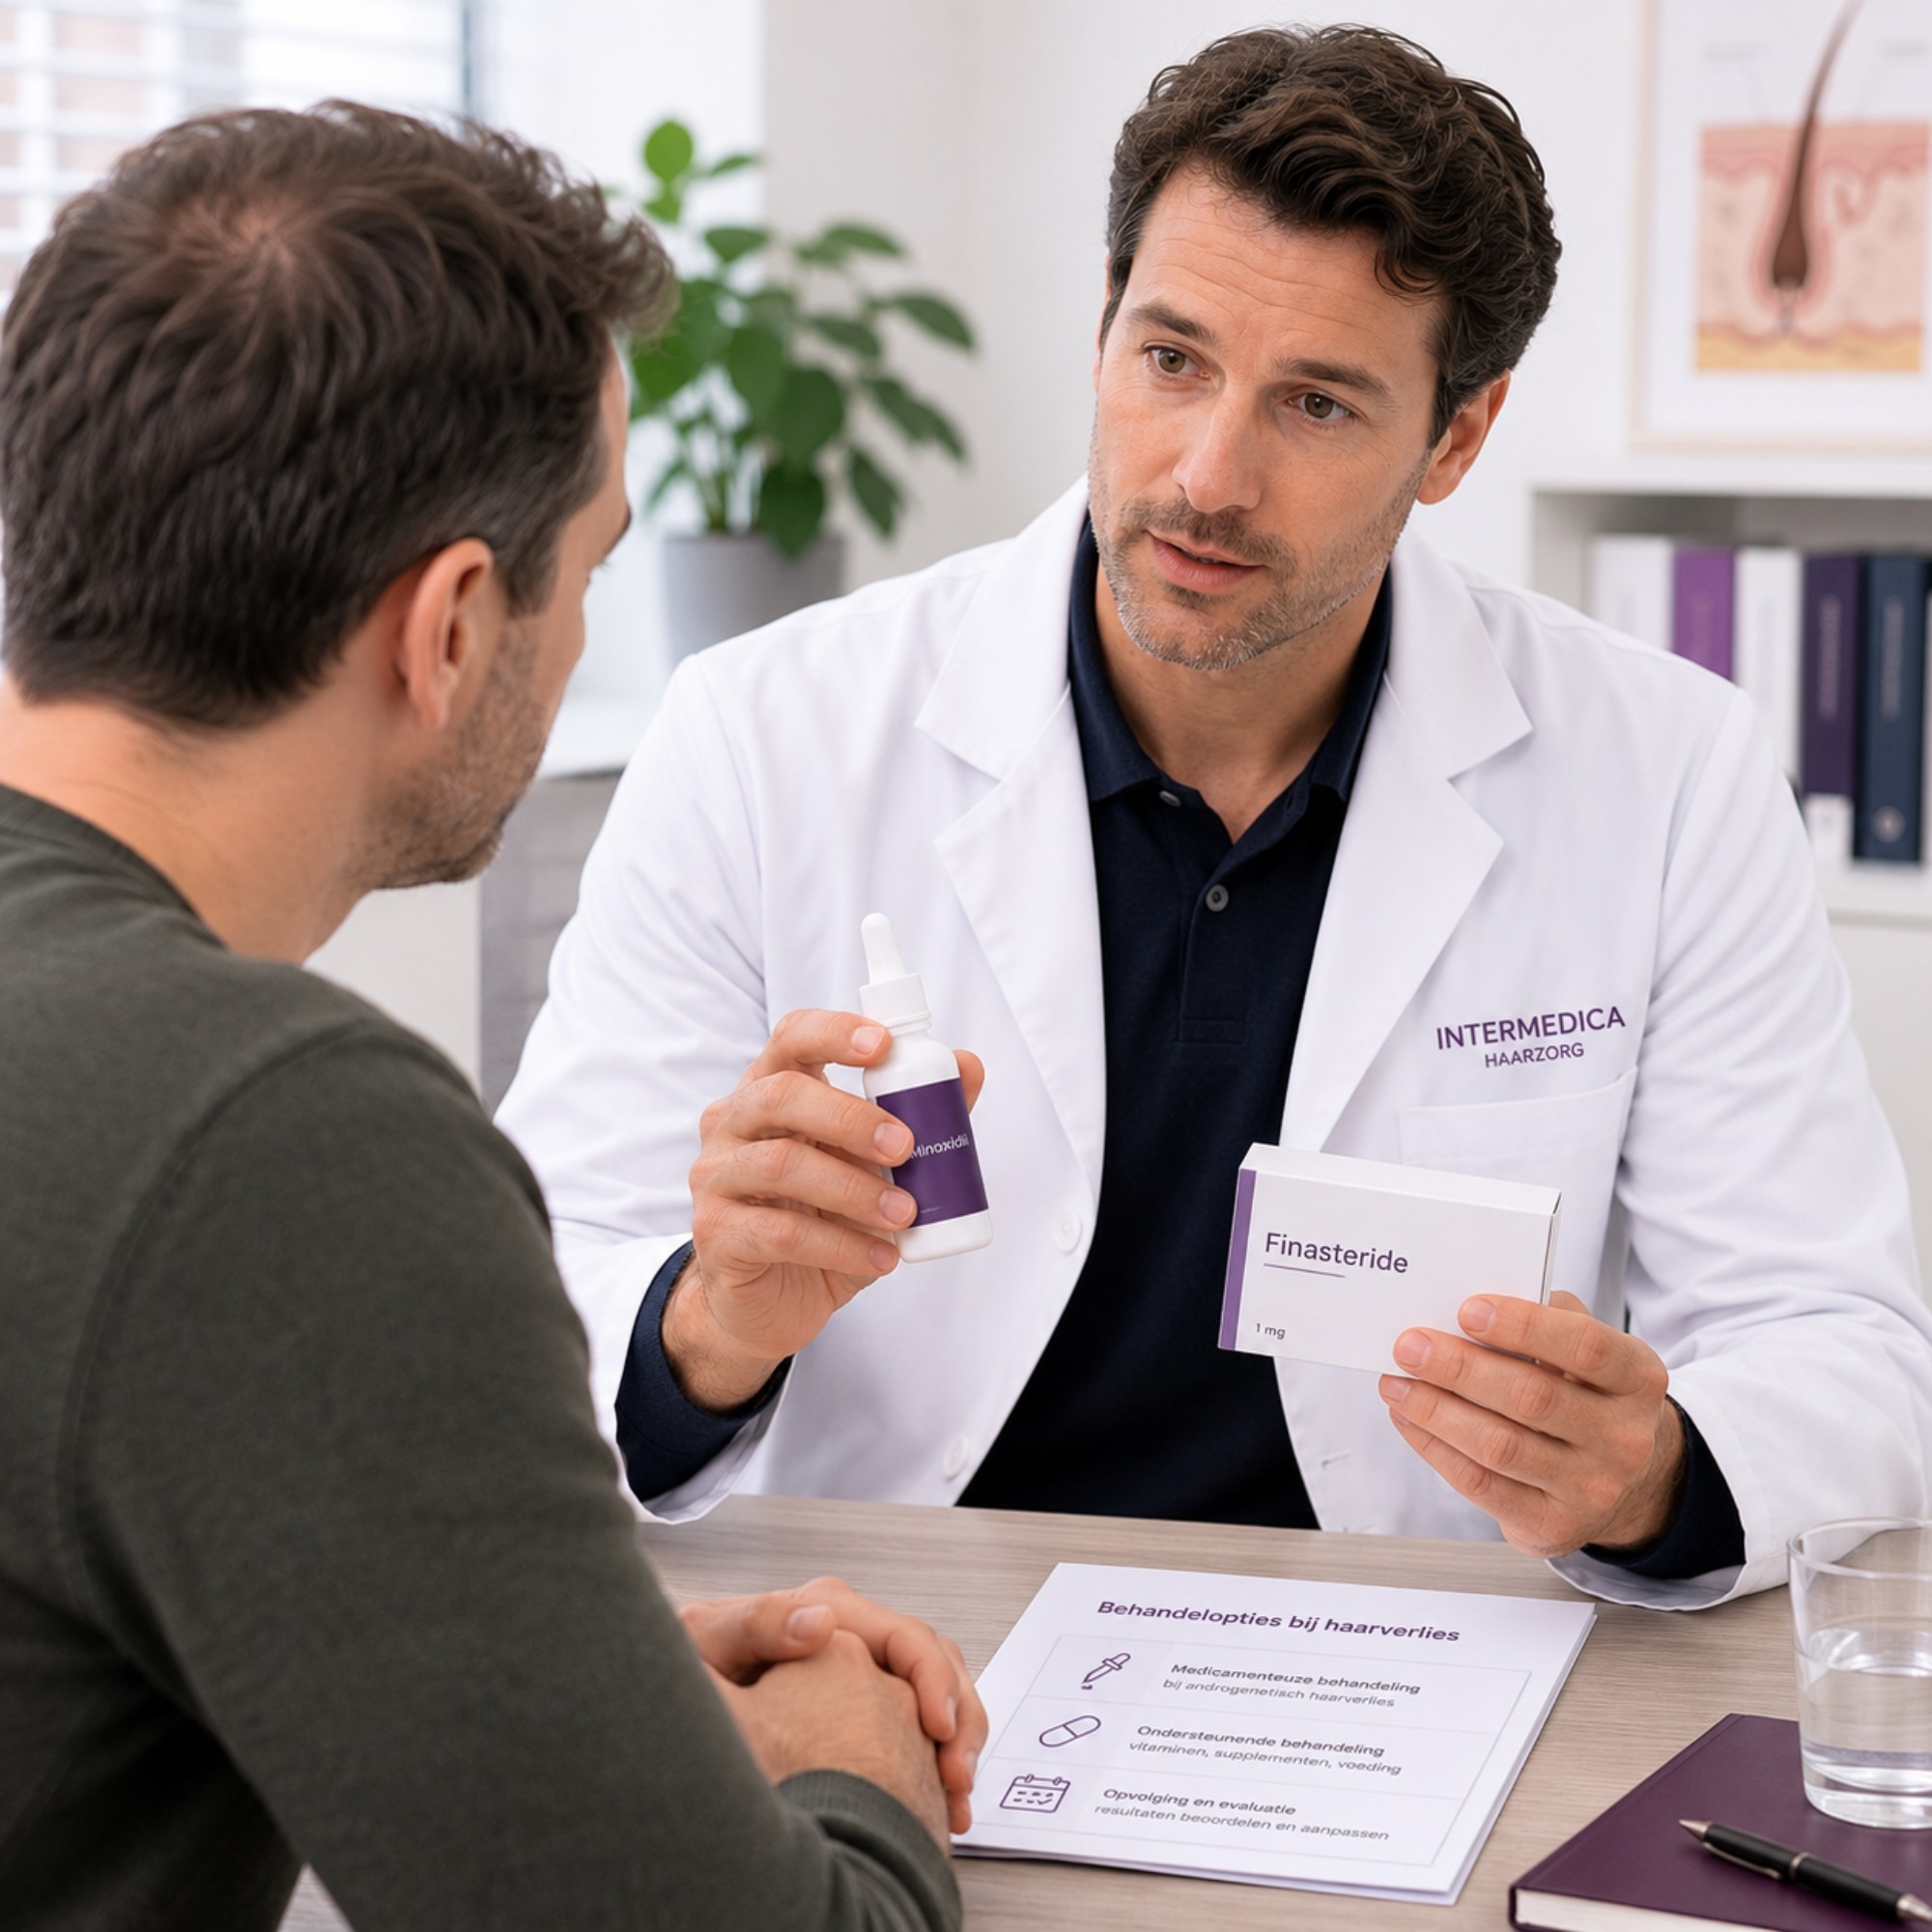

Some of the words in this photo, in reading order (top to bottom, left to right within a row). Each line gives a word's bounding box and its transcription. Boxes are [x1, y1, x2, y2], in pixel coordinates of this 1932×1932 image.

[1436, 1006, 1626, 1050] INTERMEDICA
[1485, 1042, 1584, 1067] HAARZORG
[1264, 1232, 1408, 1273] Finasteride
[1256, 1323, 1261, 1334] 1
[1264, 1325, 1286, 1339] mg
[1097, 1600, 1283, 1629] Behandelopties
[1289, 1614, 1321, 1633] bij
[1324, 1617, 1460, 1642] haarverlies
[1163, 1679, 1181, 1692] bij
[1185, 1682, 1304, 1700] androgenetisch
[1309, 1689, 1395, 1707] haarverlies
[1171, 1663, 1313, 1685] Medicamenteuze
[1318, 1673, 1420, 1695] behandeling
[1137, 1725, 1276, 1747] Ondersteunende
[1281, 1736, 1384, 1757] behandeling
[1129, 1742, 1208, 1758] vitaminen,
[1214, 1749, 1332, 1769] supplementen,
[1338, 1758, 1402, 1776] voeding
[1103, 1788, 1188, 1807] Opvolging
[1192, 1798, 1214, 1808] en
[1218, 1798, 1296, 1815] evaluatie
[1094, 1804, 1176, 1821] resultaten
[1180, 1811, 1271, 1831] beoordelen
[1276, 1821, 1296, 1831] en
[1301, 1824, 1389, 1840] aanpassen
